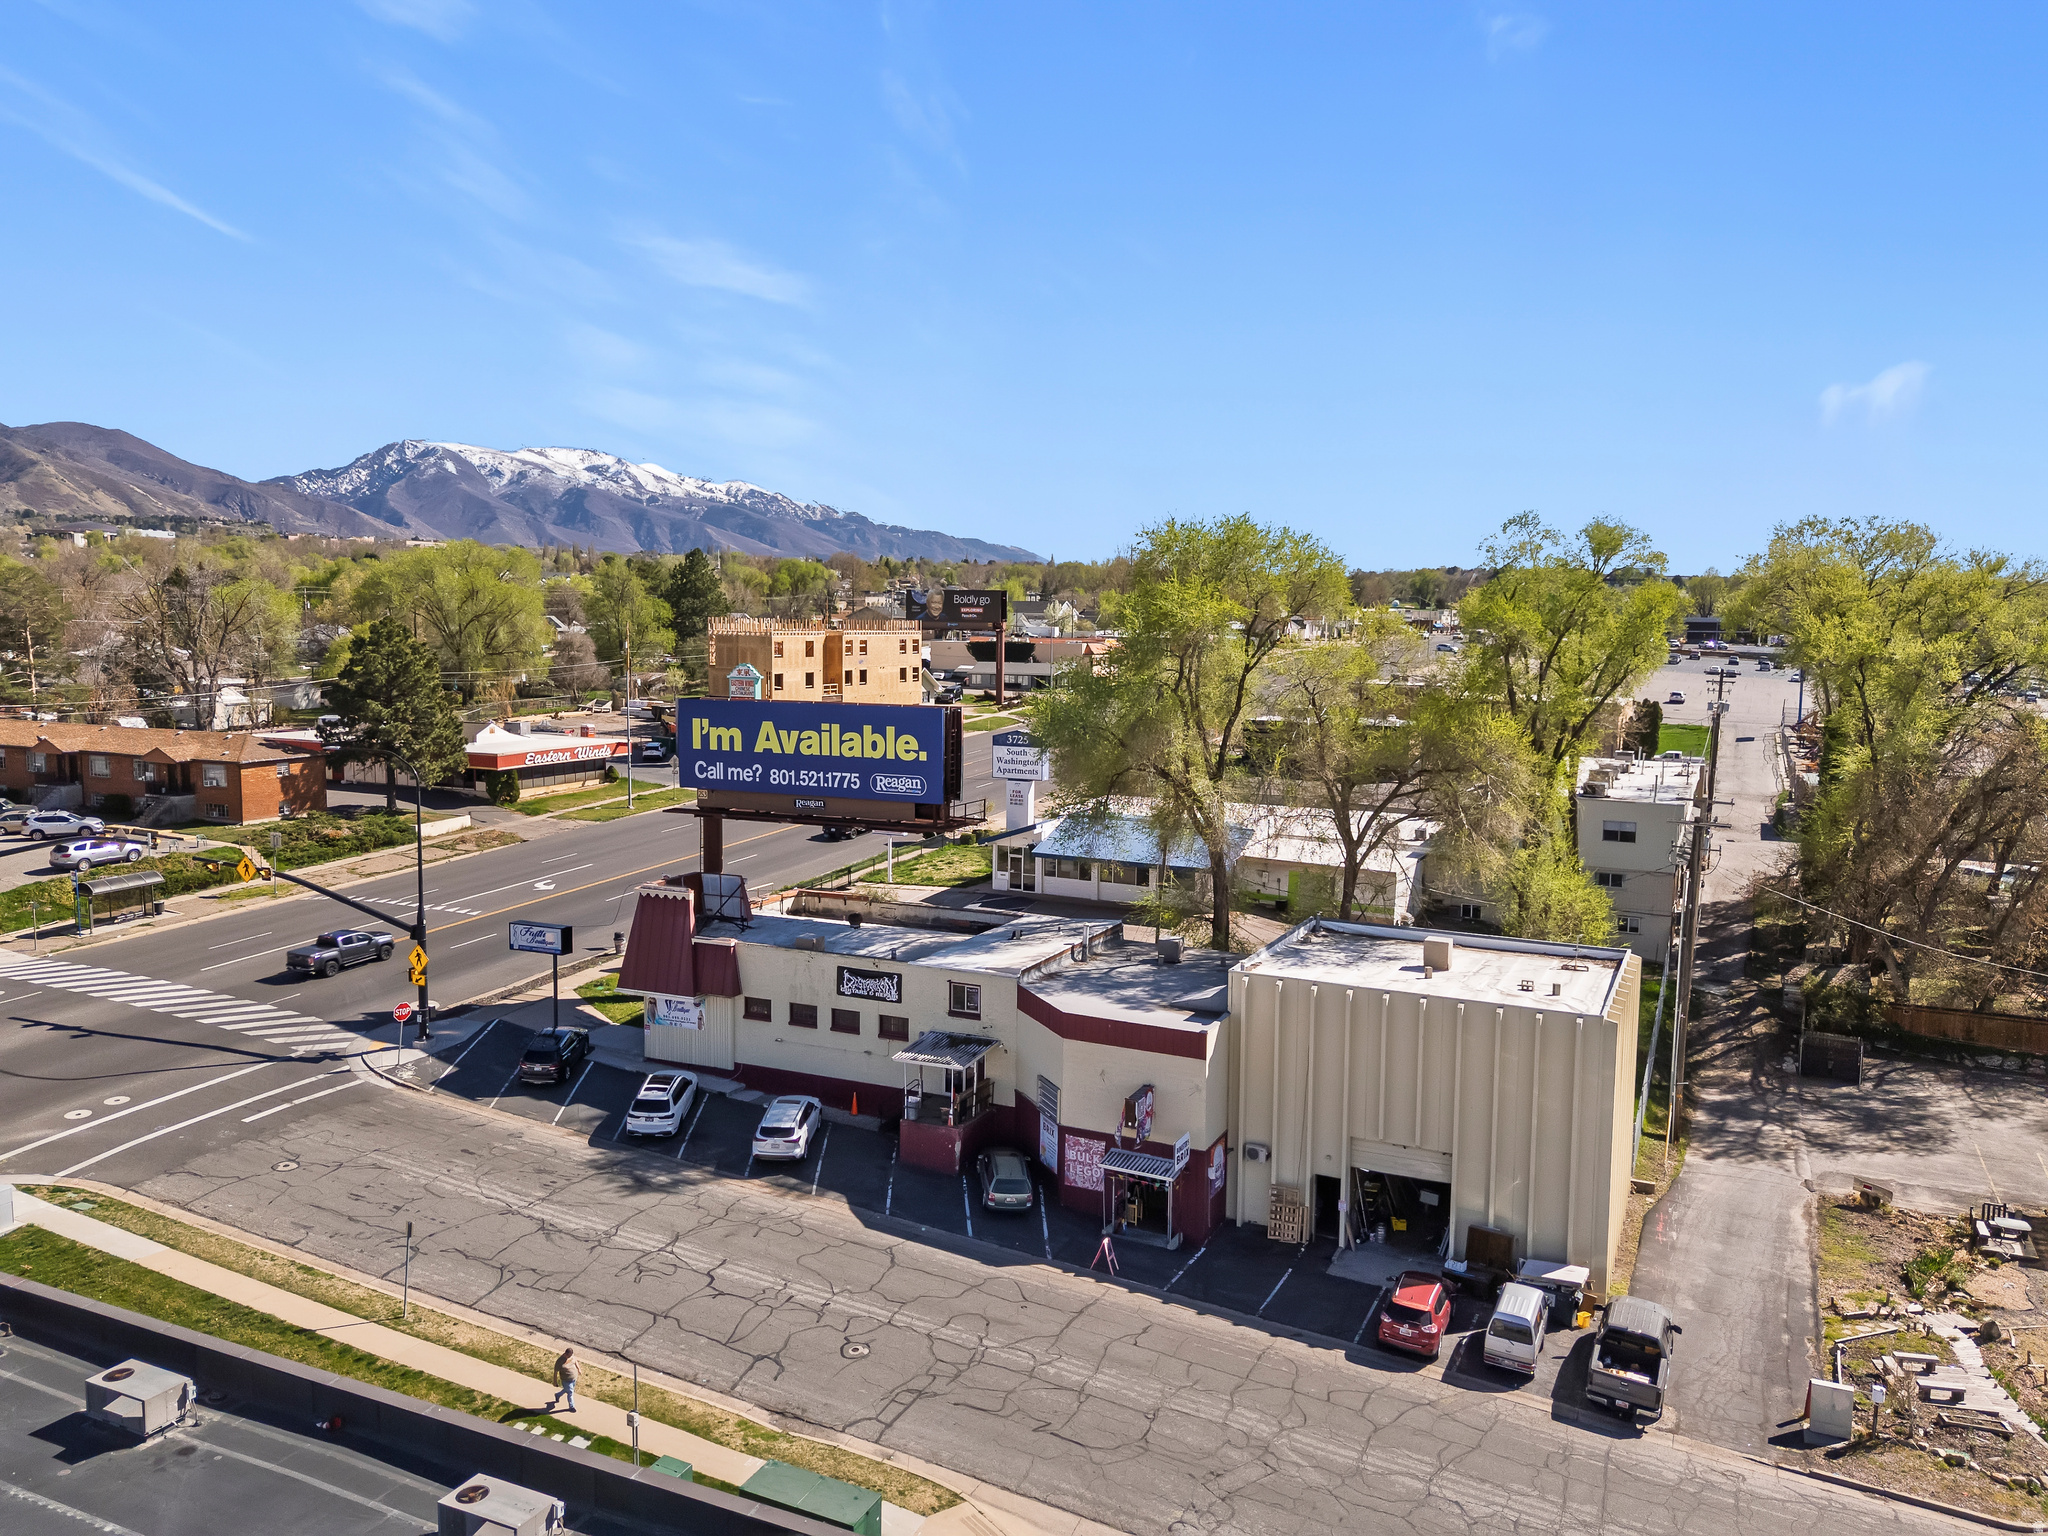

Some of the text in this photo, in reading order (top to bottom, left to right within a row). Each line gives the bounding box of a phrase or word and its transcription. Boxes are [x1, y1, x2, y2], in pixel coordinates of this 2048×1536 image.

[953, 594, 990, 606] Boldly go
[754, 721, 927, 761] Available.
[1006, 735, 1029, 744] 3725
[525, 745, 611, 765] Eastern Winds
[1006, 748, 1028, 756] South
[996, 756, 1039, 767] Washington
[694, 761, 860, 789] Call me? 801.521.1775
[996, 766, 1039, 775] Apartments
[875, 776, 922, 793] Reagan
[795, 799, 824, 809] Reagan
[395, 1007, 410, 1017] STOP
[1042, 1121, 1055, 1139] BRIX
[1069, 1150, 1100, 1164] BULK
[1176, 1147, 1189, 1165] BRIX
[1069, 1163, 1101, 1178] LEGO
